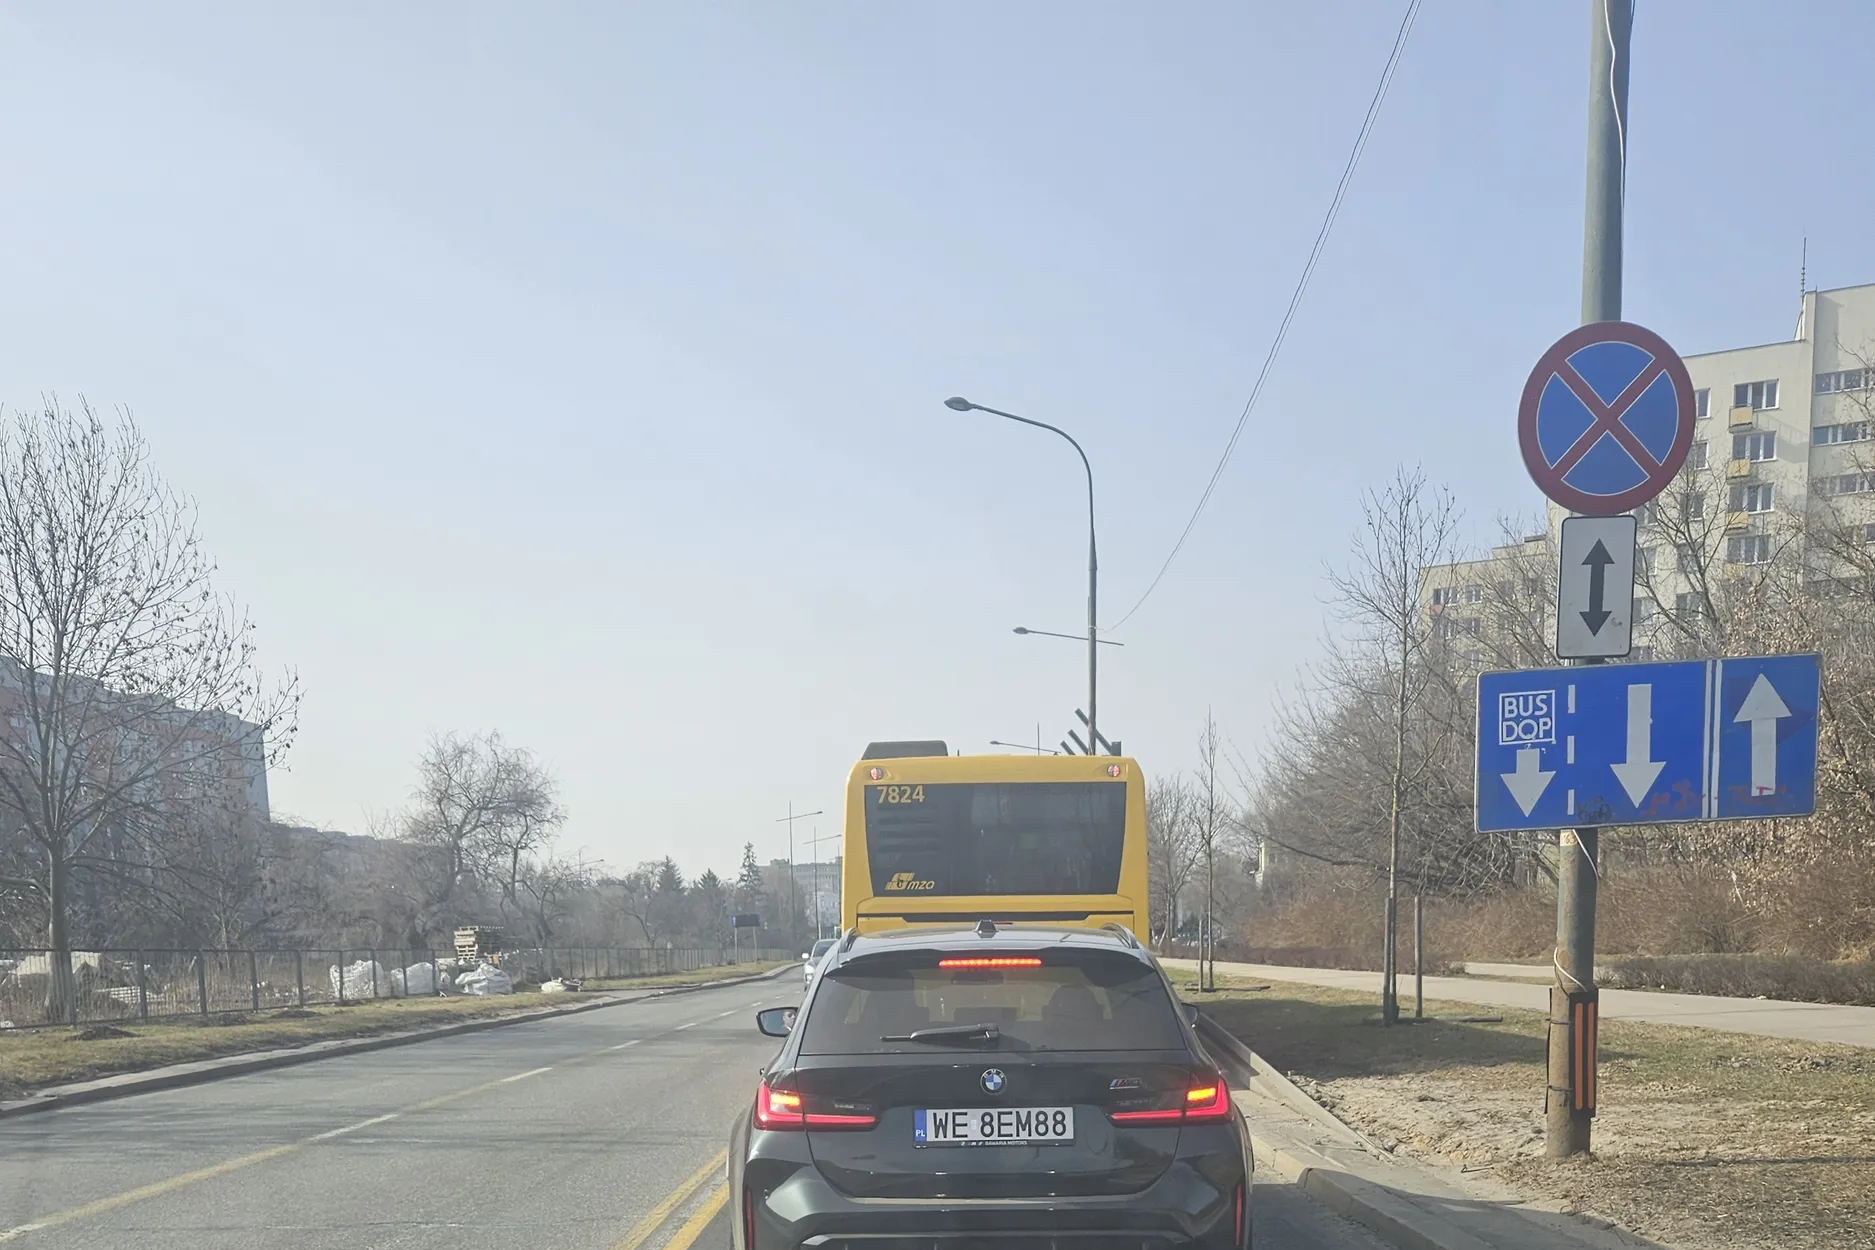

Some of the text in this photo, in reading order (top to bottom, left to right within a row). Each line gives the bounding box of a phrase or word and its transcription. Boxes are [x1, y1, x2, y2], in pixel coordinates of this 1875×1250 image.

[1504, 694, 1548, 718] BUS
[1502, 717, 1552, 741] DOP
[876, 785, 925, 804] 7824
[915, 1129, 926, 1137] PL
[932, 1110, 1067, 1139] WE 8EM88
